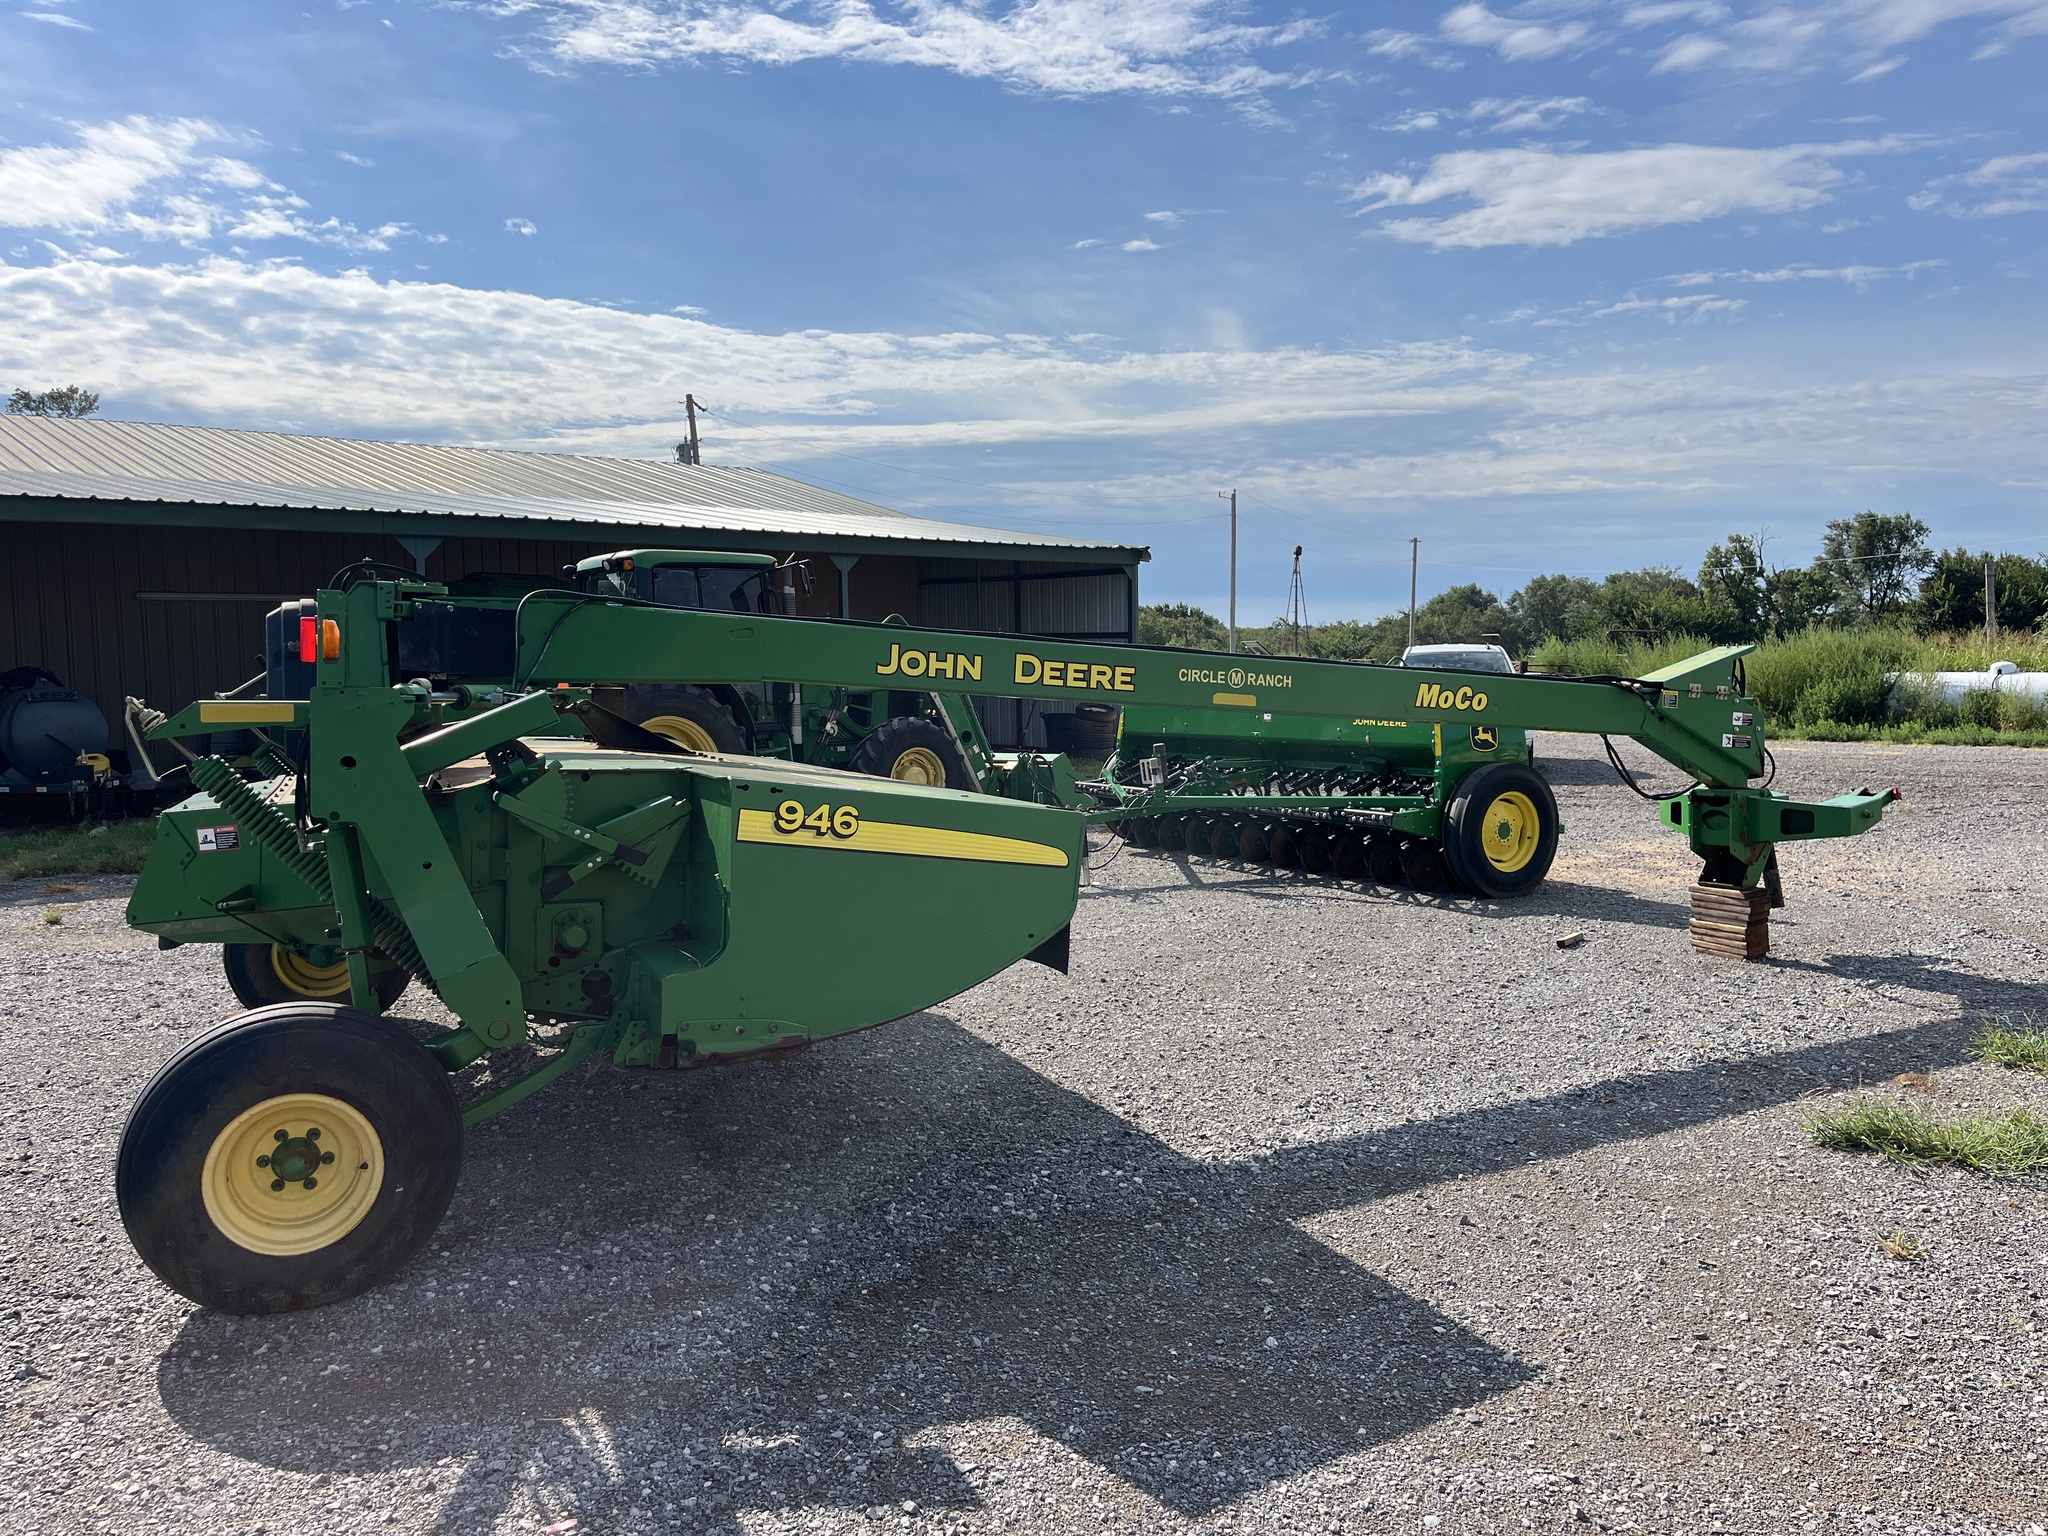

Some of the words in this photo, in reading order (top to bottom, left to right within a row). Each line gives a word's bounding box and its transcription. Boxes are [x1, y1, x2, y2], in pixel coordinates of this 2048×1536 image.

[876, 642, 983, 682] JOHN
[1014, 652, 1136, 692] DEERE
[1178, 668, 1226, 684] CIRCLE
[1247, 672, 1292, 688] RANCH
[1414, 682, 1489, 712] MoCo
[1352, 718, 1376, 726] JOHN
[774, 799, 860, 839] 946
